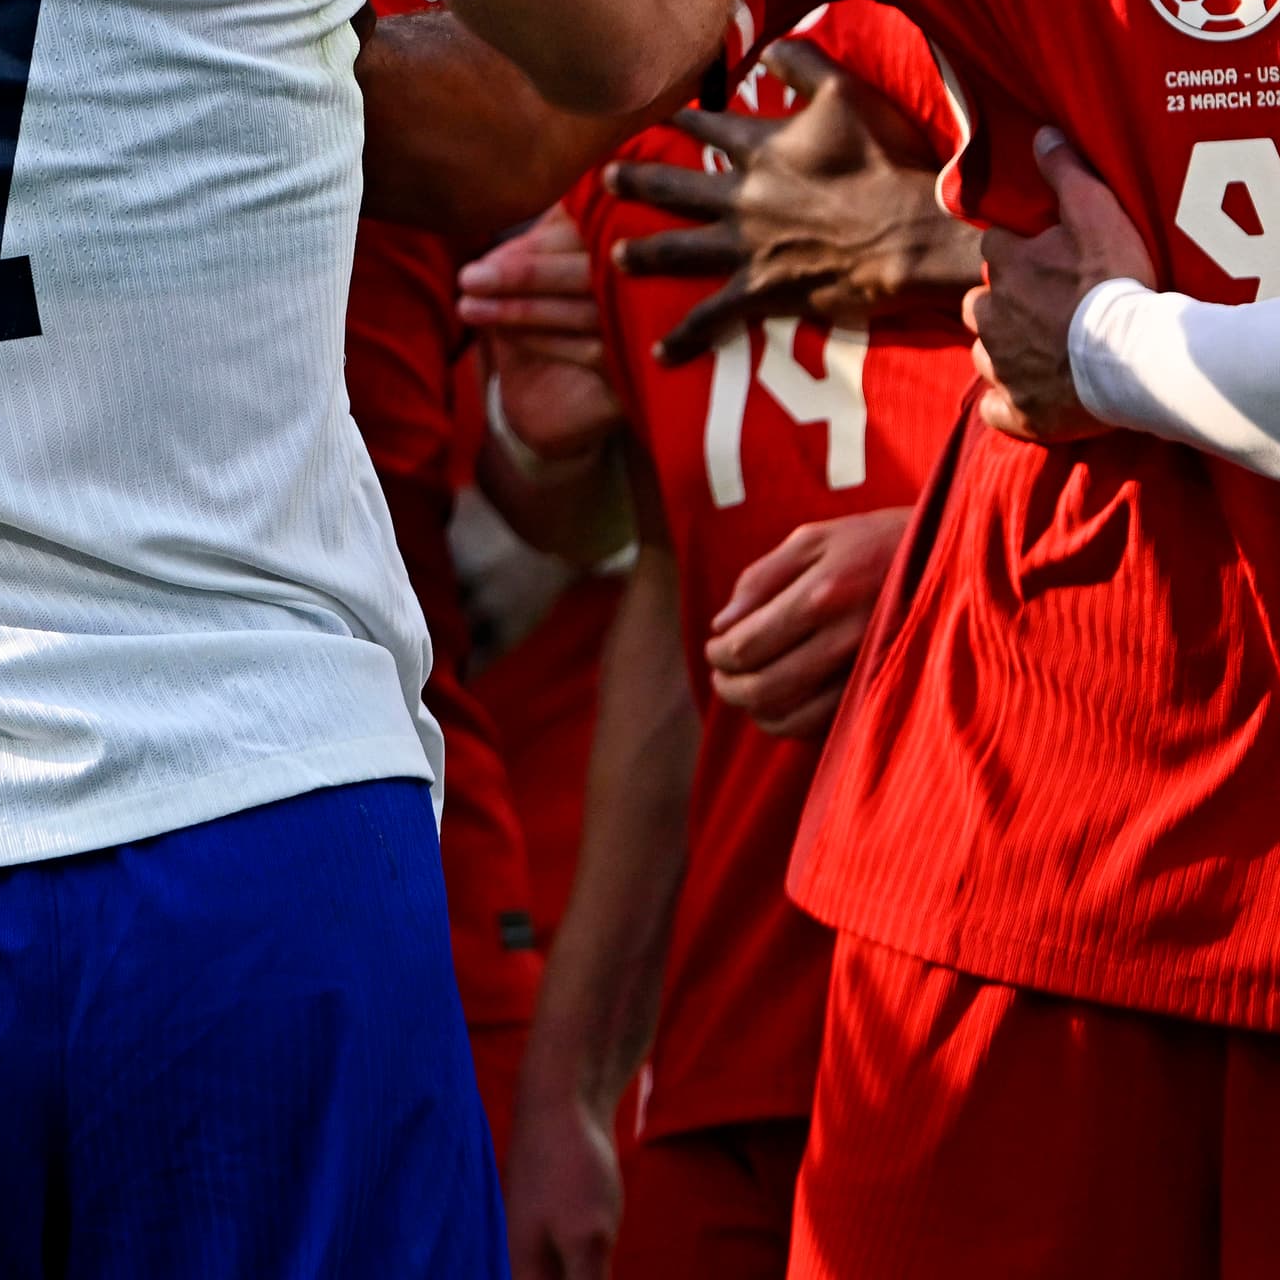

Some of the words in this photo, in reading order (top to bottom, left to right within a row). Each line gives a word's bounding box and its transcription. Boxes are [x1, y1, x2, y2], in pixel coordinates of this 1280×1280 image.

[1165, 67, 1238, 88] CANADA
[1166, 95, 1186, 112] 23
[1190, 91, 1252, 111] MARCH
